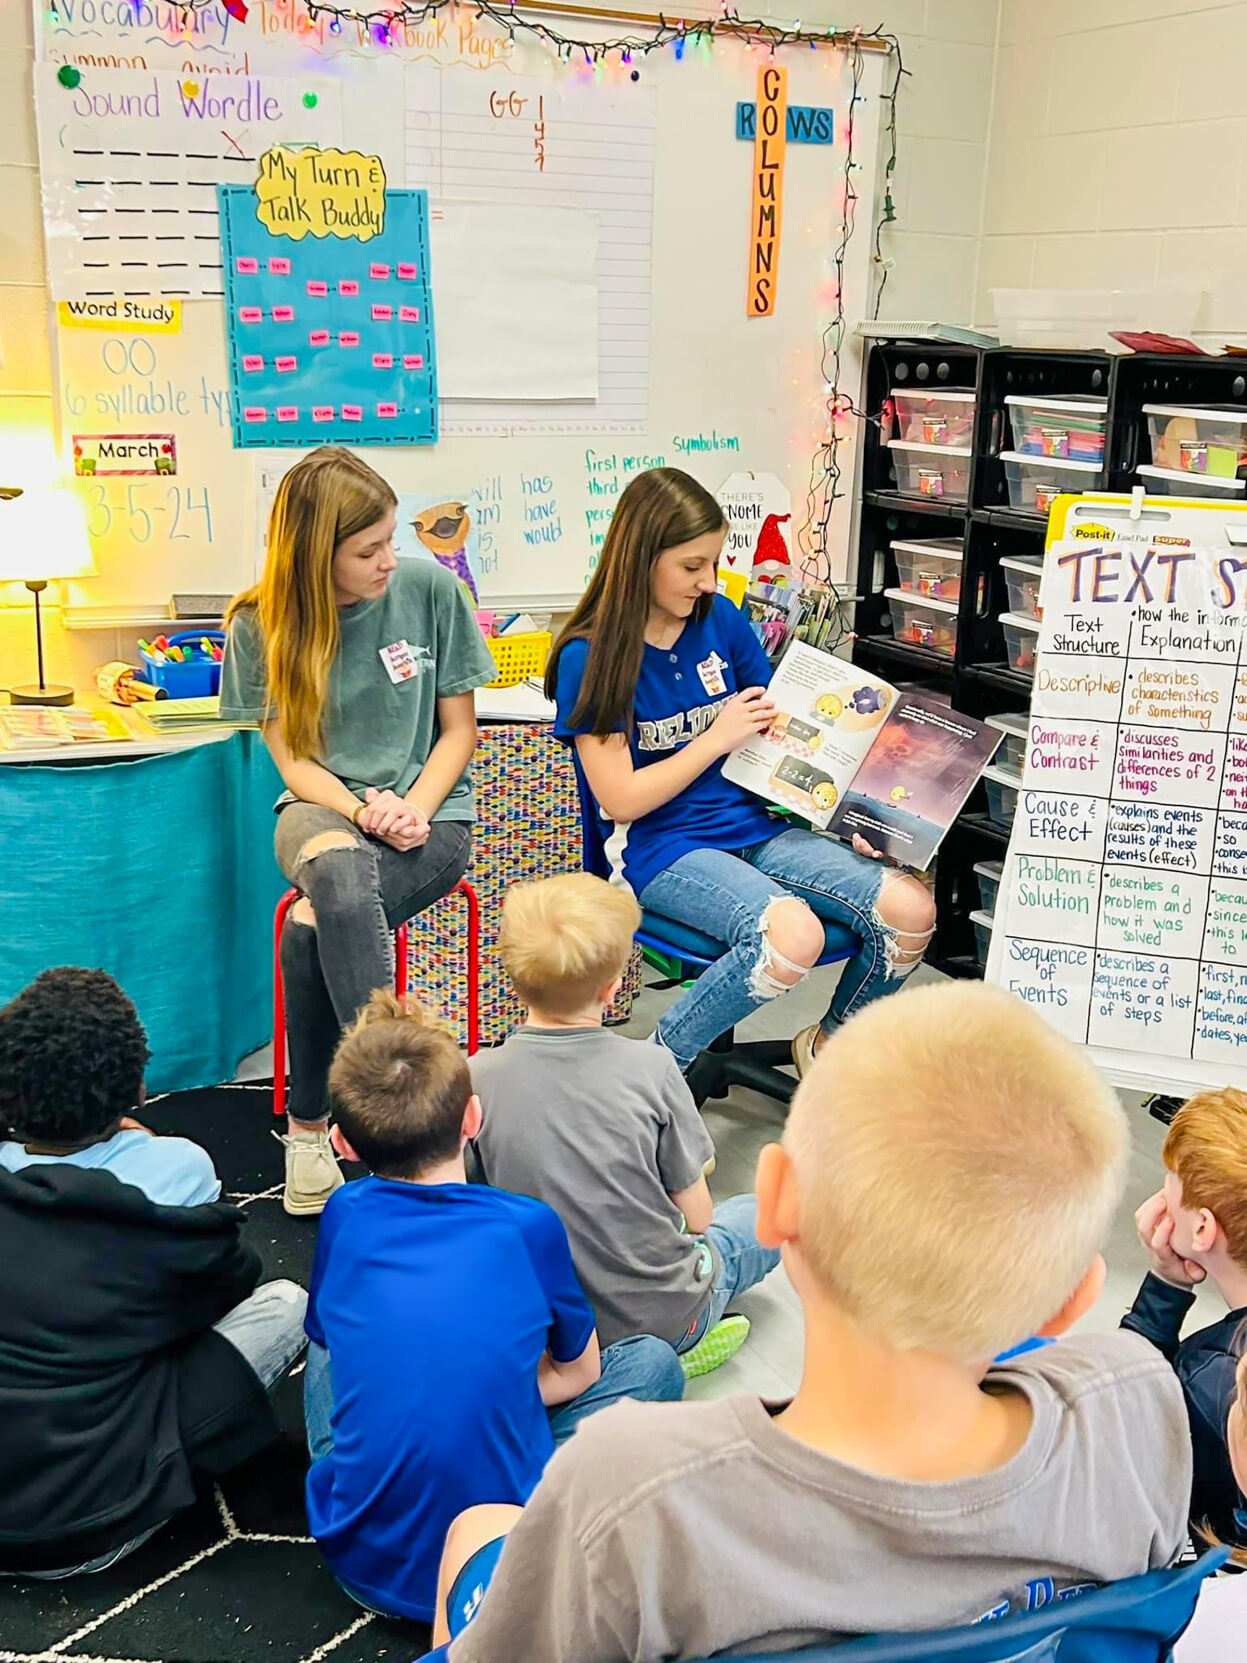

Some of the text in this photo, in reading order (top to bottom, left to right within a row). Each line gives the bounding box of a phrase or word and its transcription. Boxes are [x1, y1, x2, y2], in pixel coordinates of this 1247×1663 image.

[176, 79, 283, 122] Wordle
[268, 151, 297, 196] My
[304, 154, 360, 187] Turn
[754, 69, 780, 313] COLUMNS
[263, 196, 380, 236] Talk Buddy
[68, 301, 174, 324] Word Study
[97, 380, 190, 423] syllable
[99, 442, 159, 458] March
[673, 430, 740, 455] symbolism
[585, 450, 617, 472] first
[521, 474, 552, 494] has
[586, 477, 619, 496] third
[721, 492, 764, 502] THERE'S
[88, 483, 212, 543] 3-5-24
[524, 499, 556, 521] have
[586, 509, 614, 528] pers
[1058, 547, 1195, 603] TEXT
[1064, 614, 1104, 633] Text
[1138, 605, 1162, 622] how
[1168, 607, 1189, 623] the
[1053, 634, 1120, 656] Structure
[1141, 625, 1235, 655] Explanation
[1038, 669, 1122, 697] Descriptive
[1138, 667, 1199, 686] describes
[1131, 685, 1219, 704] characteristics
[1128, 701, 1213, 729] of something
[1031, 725, 1087, 748] Compare
[1124, 729, 1179, 748] discusses
[1031, 748, 1099, 771] Contrast
[1118, 746, 1214, 765] similarities and
[1117, 759, 1216, 782] differences of 2
[1119, 777, 1158, 796] things
[1025, 792, 1080, 817] Cause
[1115, 804, 1203, 823] explains events
[1029, 818, 1093, 842] Effect
[1151, 820, 1173, 835] and
[1176, 824, 1197, 836] the
[1107, 833, 1197, 850] results of these
[1107, 848, 1197, 869] events (effect)
[1217, 861, 1238, 875] this
[1018, 857, 1081, 885] Problem
[1109, 874, 1180, 896] describes a
[1017, 883, 1090, 915] Solution
[1104, 894, 1191, 914] problem and
[1104, 912, 1183, 931] how it was
[1212, 926, 1234, 939] this
[1123, 929, 1161, 946] solved
[1221, 941, 1236, 955] to
[1009, 939, 1088, 970] Sequence
[1100, 953, 1169, 974] describes a
[1040, 963, 1056, 981] of
[1094, 972, 1171, 991] sequence of
[1093, 986, 1192, 1008] events or a list
[1100, 1002, 1162, 1026] of steps
